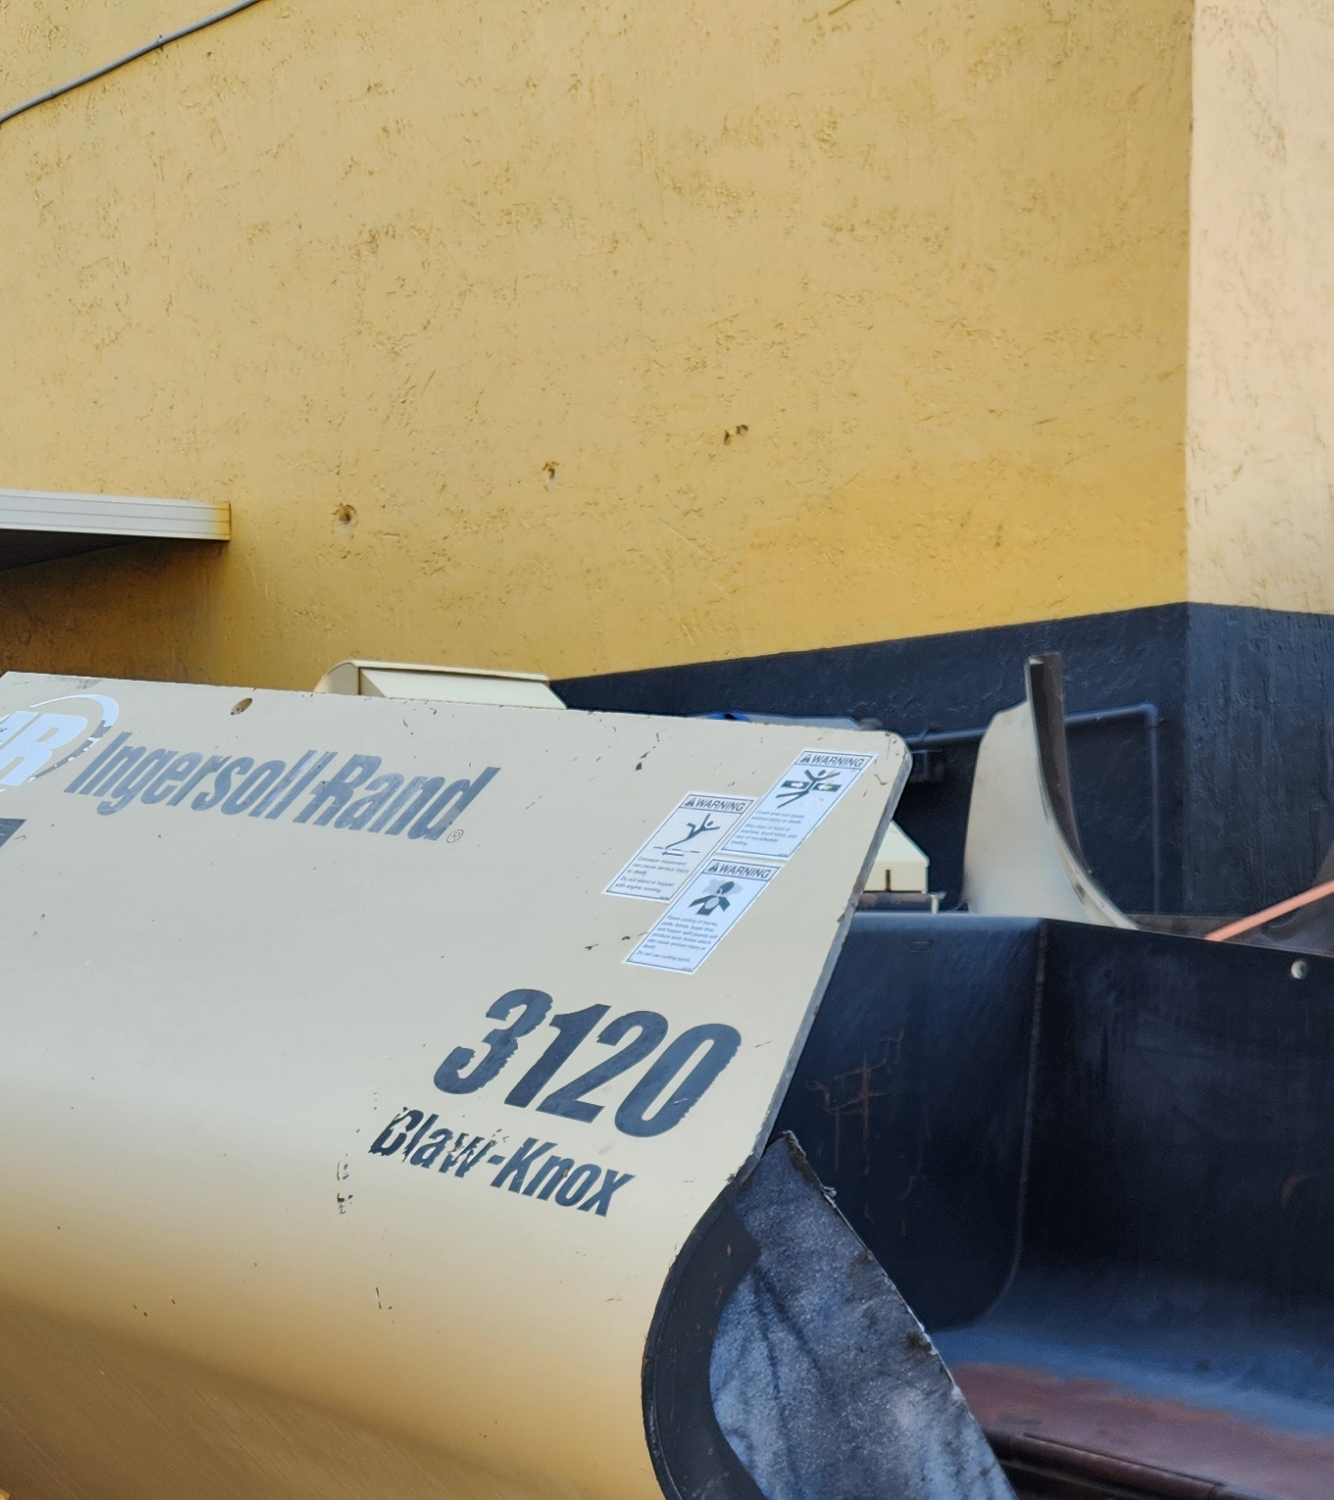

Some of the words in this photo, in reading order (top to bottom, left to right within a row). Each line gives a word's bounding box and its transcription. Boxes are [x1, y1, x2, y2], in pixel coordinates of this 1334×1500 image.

[810, 754, 864, 767] WARNING
[695, 798, 745, 811] WARNING
[718, 863, 770, 878] WARNING
[434, 988, 742, 1137] 3120
[368, 1107, 636, 1217] Blaw-Knox
